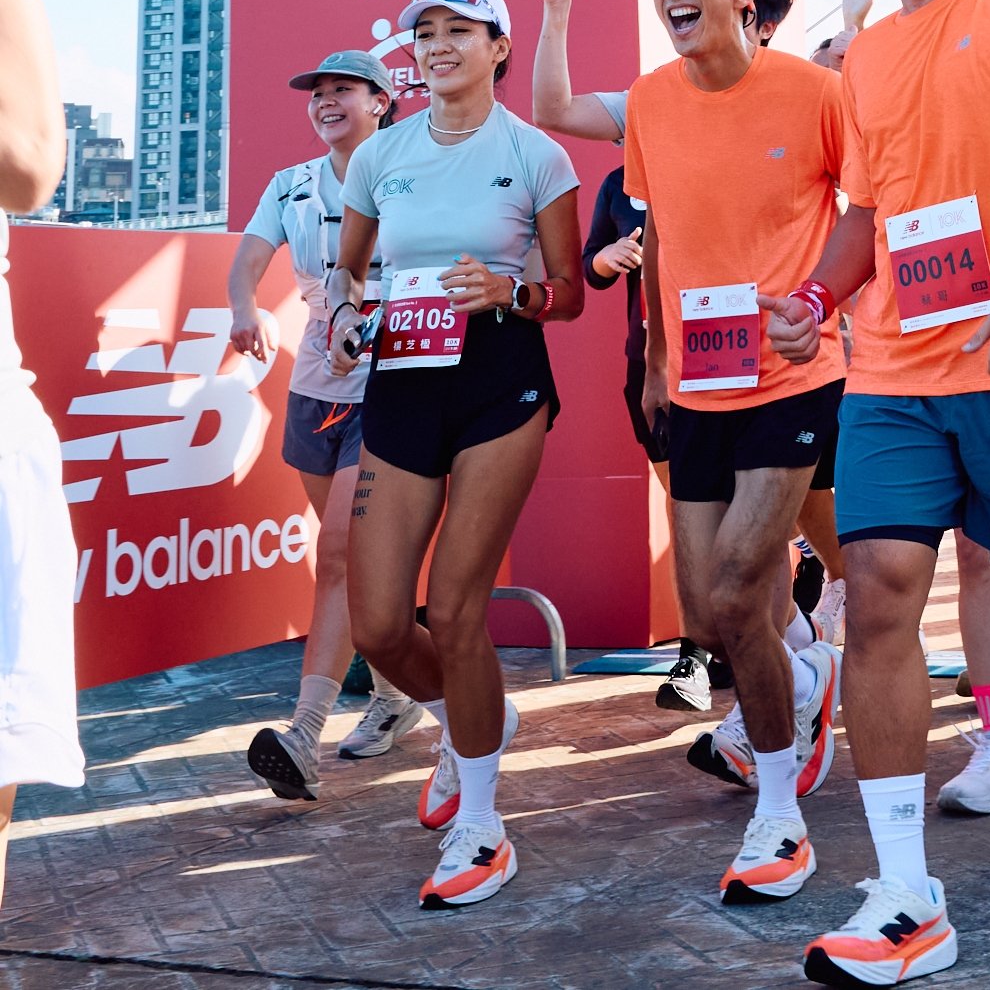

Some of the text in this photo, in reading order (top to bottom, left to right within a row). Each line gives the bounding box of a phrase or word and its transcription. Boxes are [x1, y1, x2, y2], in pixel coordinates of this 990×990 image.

[382, 178, 416, 197] 10K
[898, 248, 975, 287] 00014
[388, 308, 456, 333] 02105
[687, 328, 749, 353] 00018
[105, 513, 310, 598] balance
